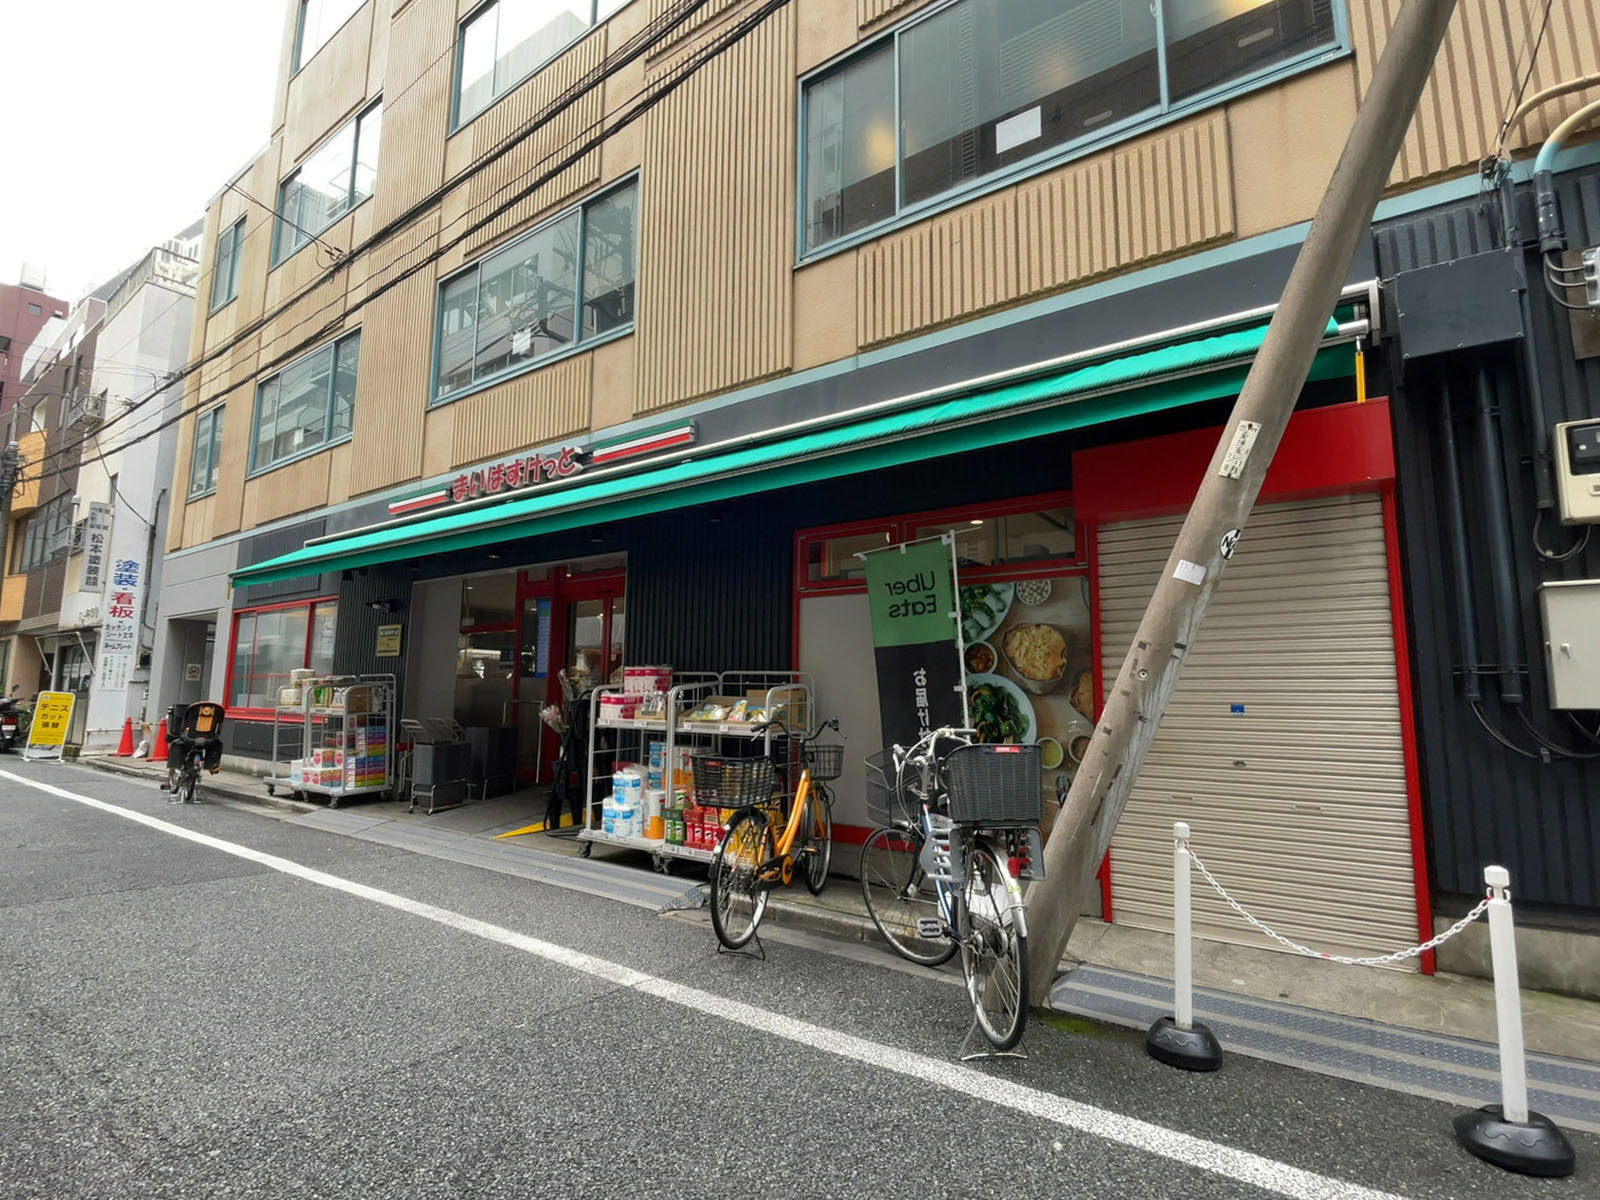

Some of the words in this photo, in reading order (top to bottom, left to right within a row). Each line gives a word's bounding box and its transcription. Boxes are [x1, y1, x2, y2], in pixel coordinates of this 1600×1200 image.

[452, 446, 579, 502] まいばすけっと
[40, 703, 69, 712] テニス
